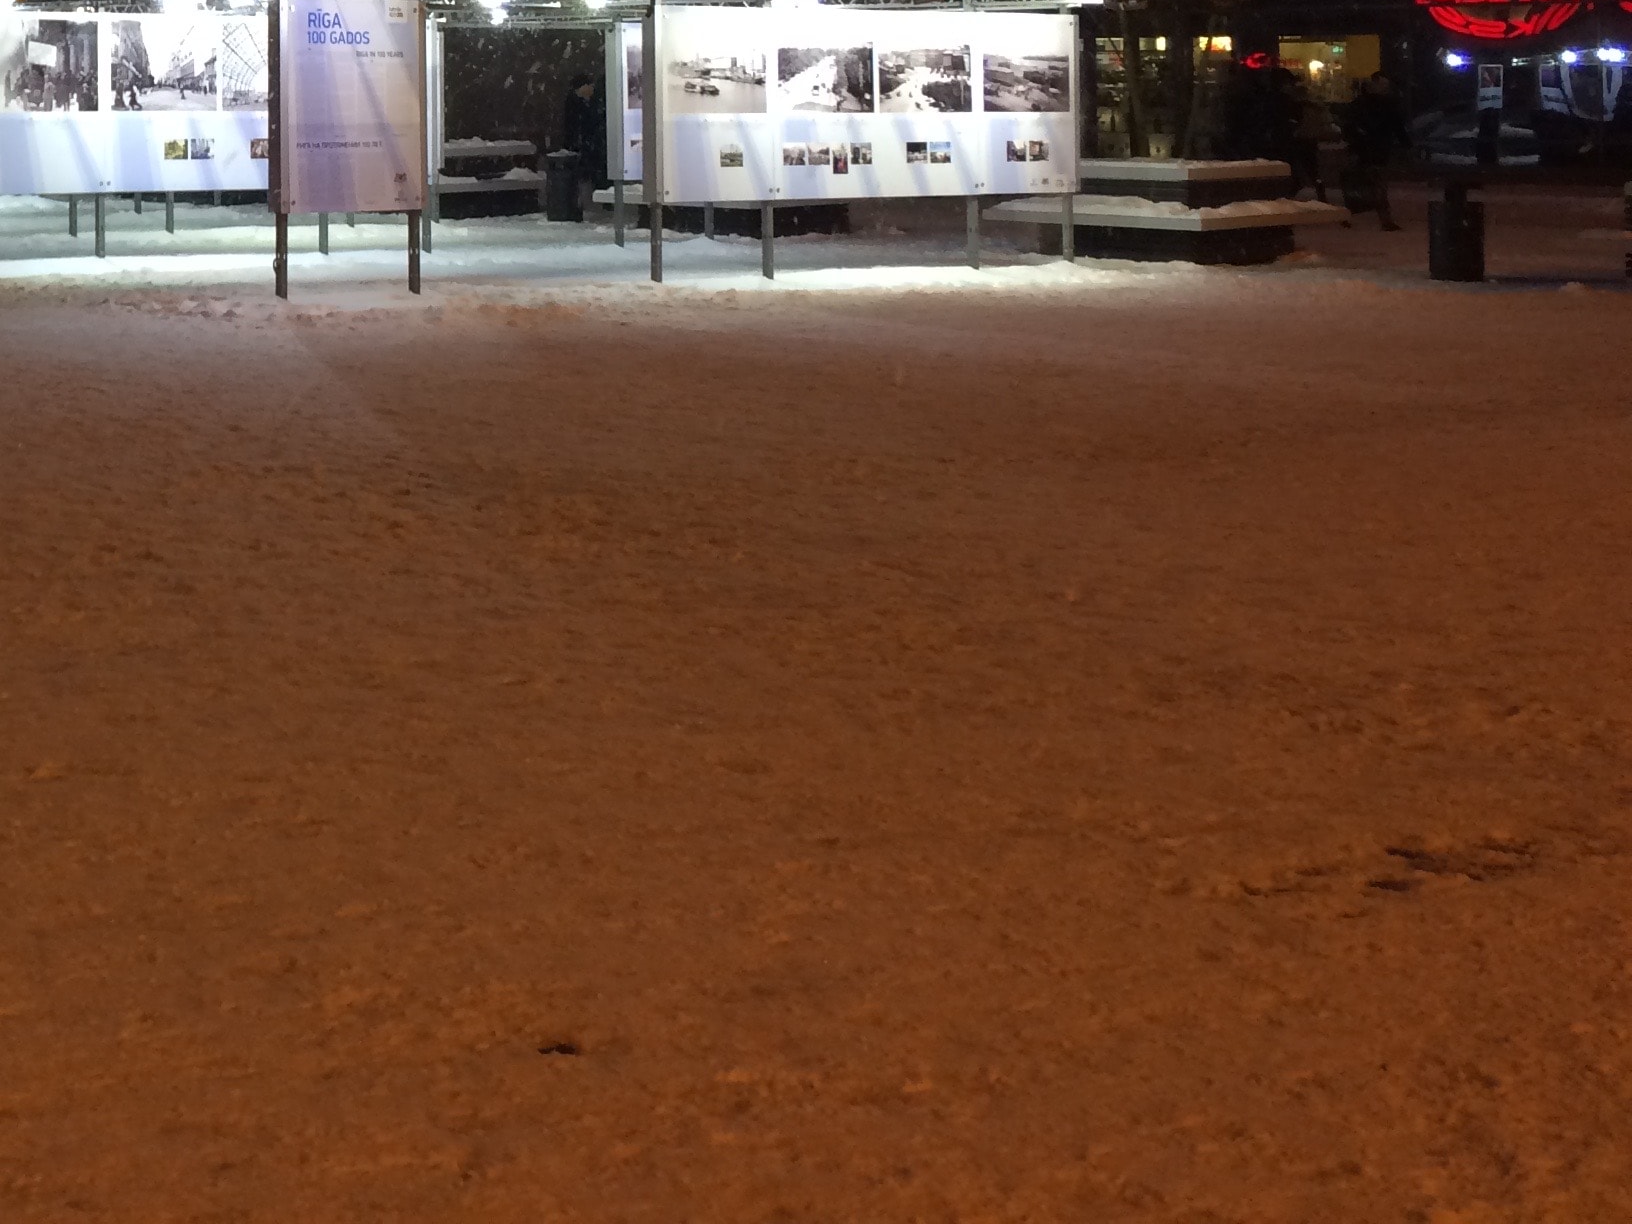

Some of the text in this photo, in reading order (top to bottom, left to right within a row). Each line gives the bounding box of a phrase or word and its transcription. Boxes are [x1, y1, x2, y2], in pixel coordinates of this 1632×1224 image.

[307, 9, 342, 28] RĪGA
[307, 31, 370, 45] 100 GADOS
